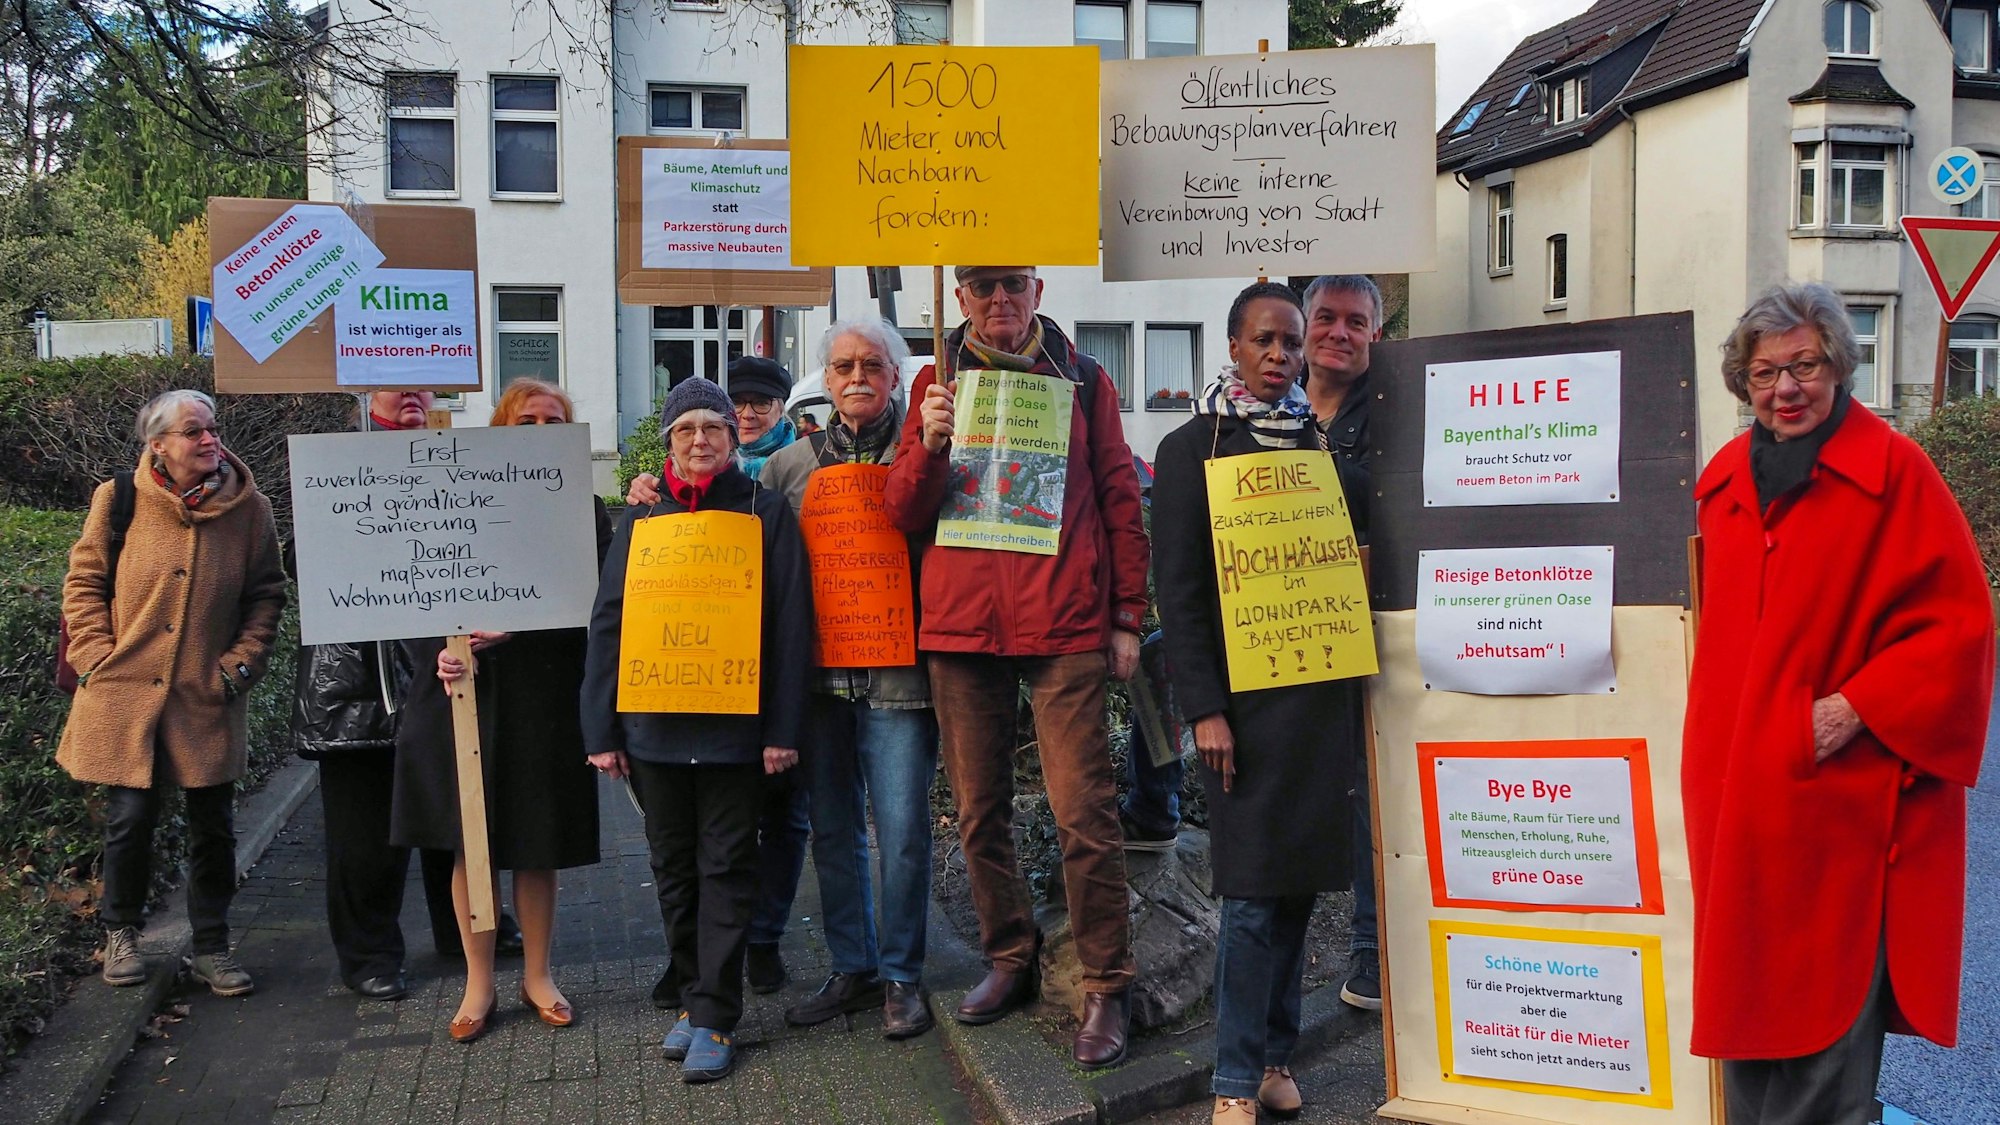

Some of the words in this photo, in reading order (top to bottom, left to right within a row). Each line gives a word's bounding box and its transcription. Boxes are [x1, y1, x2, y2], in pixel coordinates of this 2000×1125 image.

[868, 62, 997, 109] 1500
[1181, 66, 1336, 107] Öffentliches
[859, 120, 938, 151] Mieter
[954, 116, 1007, 150] und
[1110, 110, 1397, 151] Bebauungsplanverfahren
[663, 163, 708, 175] Bäume,
[711, 164, 762, 175] Atemluft
[766, 165, 788, 175] und
[858, 155, 991, 185] Nachbarn
[1259, 167, 1337, 190] interne
[690, 182, 761, 193] Klimaschutz
[712, 203, 739, 213] statt
[869, 195, 988, 238] fordern:
[1119, 200, 1248, 227] Vereinbarung
[1260, 204, 1300, 221] von
[1315, 194, 1384, 221] Stadt
[664, 222, 751, 234] Parkzerstörung
[754, 224, 788, 233] durch
[224, 245, 261, 275] Keine
[259, 213, 298, 247] neuen
[668, 242, 714, 251] massive
[718, 243, 783, 253] Neubauten
[1161, 231, 1203, 258] und
[1226, 230, 1319, 255] Investor
[235, 226, 323, 301] Betonklötze
[250, 306, 267, 324] in
[267, 276, 305, 314] unsere
[304, 243, 346, 279] einzige
[360, 285, 448, 311] Klima
[270, 307, 310, 345] grüne
[305, 278, 346, 314] Lunge
[348, 324, 367, 336] ist
[371, 324, 437, 338] wichtiger
[442, 324, 462, 336] als
[340, 344, 473, 357] Investoren-Profit
[510, 339, 549, 347] SCHICK
[978, 377, 1047, 392] Bayenthals
[974, 395, 1010, 408] grüne
[1013, 397, 1047, 411] Oase
[1006, 415, 1039, 429] nicht
[1547, 422, 1598, 439] Klima
[409, 437, 471, 465] Erst
[1010, 436, 1059, 451] werden
[1062, 440, 1066, 451] !
[1465, 454, 1509, 465] braucht
[1512, 453, 1550, 464] Schutz
[1553, 453, 1572, 462] vor
[304, 466, 430, 493] zuverlässige
[446, 463, 564, 491] Verwaltung
[1236, 463, 1312, 496] KEINE
[1456, 476, 1495, 487] neuem
[1499, 474, 1532, 485] Beton
[1536, 474, 1551, 483] im
[1554, 472, 1580, 483] Park
[332, 494, 372, 514] und
[384, 491, 505, 519] gründliche
[356, 516, 477, 536] Sanierung
[1213, 503, 1335, 530] ZUSÄTZLICHEN
[672, 522, 709, 538] DEN
[943, 529, 963, 539] Hier
[966, 531, 1056, 548] unterschreiben.
[406, 539, 472, 561] Dann
[834, 537, 855, 549] und
[636, 544, 748, 567] BESTAND
[380, 562, 498, 590] maßvoller
[1435, 569, 1489, 585] Riesige
[1495, 566, 1593, 582] Betonklötze
[329, 582, 542, 611] Wohnungsneubau
[837, 596, 859, 607] und
[1434, 595, 1446, 606] in
[1450, 595, 1500, 606] unserer
[1504, 594, 1552, 608] grünen
[1557, 593, 1592, 606] Oase
[662, 622, 710, 647] NEU
[1477, 618, 1504, 630] sind
[1509, 618, 1543, 630] nicht
[833, 630, 908, 643] NEUBAUTEN
[1242, 620, 1359, 652] BAYENTHAL
[846, 645, 887, 660] PARK
[1560, 643, 1565, 658] !
[627, 659, 714, 687] BAUEN
[1488, 779, 1526, 802] Bye
[1533, 779, 1572, 803] Bye
[1449, 811, 1468, 821] alte
[1471, 811, 1510, 824] Bäume,
[1513, 813, 1544, 823] Raum
[1547, 814, 1563, 824] für
[1566, 814, 1595, 825] Tiere
[1598, 814, 1620, 825] und
[1461, 830, 1519, 842] Menschen,
[1521, 832, 1574, 844] Erholung,
[1577, 833, 1610, 844] Ruhe,
[1462, 847, 1537, 861] Hitzeausgleich
[1540, 850, 1571, 861] durch
[1574, 852, 1612, 862] unsere
[1492, 869, 1538, 886] grüne
[1542, 870, 1583, 885] Oase
[1485, 955, 1542, 973] Schöne
[1547, 960, 1599, 978] Worte
[1466, 979, 1482, 990] für
[1485, 981, 1502, 992] die
[1505, 983, 1623, 1006] Projektvermarktung
[1520, 1005, 1546, 1017] aber
[1550, 1008, 1567, 1019] die
[1465, 1020, 1520, 1039] Realität
[1525, 1026, 1546, 1041] für
[1550, 1029, 1574, 1044] die
[1578, 1032, 1630, 1050] Mieter
[1471, 1045, 1498, 1058] sieht
[1501, 1049, 1534, 1061] schon
[1536, 1052, 1563, 1065] jetzt
[1566, 1056, 1606, 1070] anders
[1610, 1061, 1631, 1071] aus
